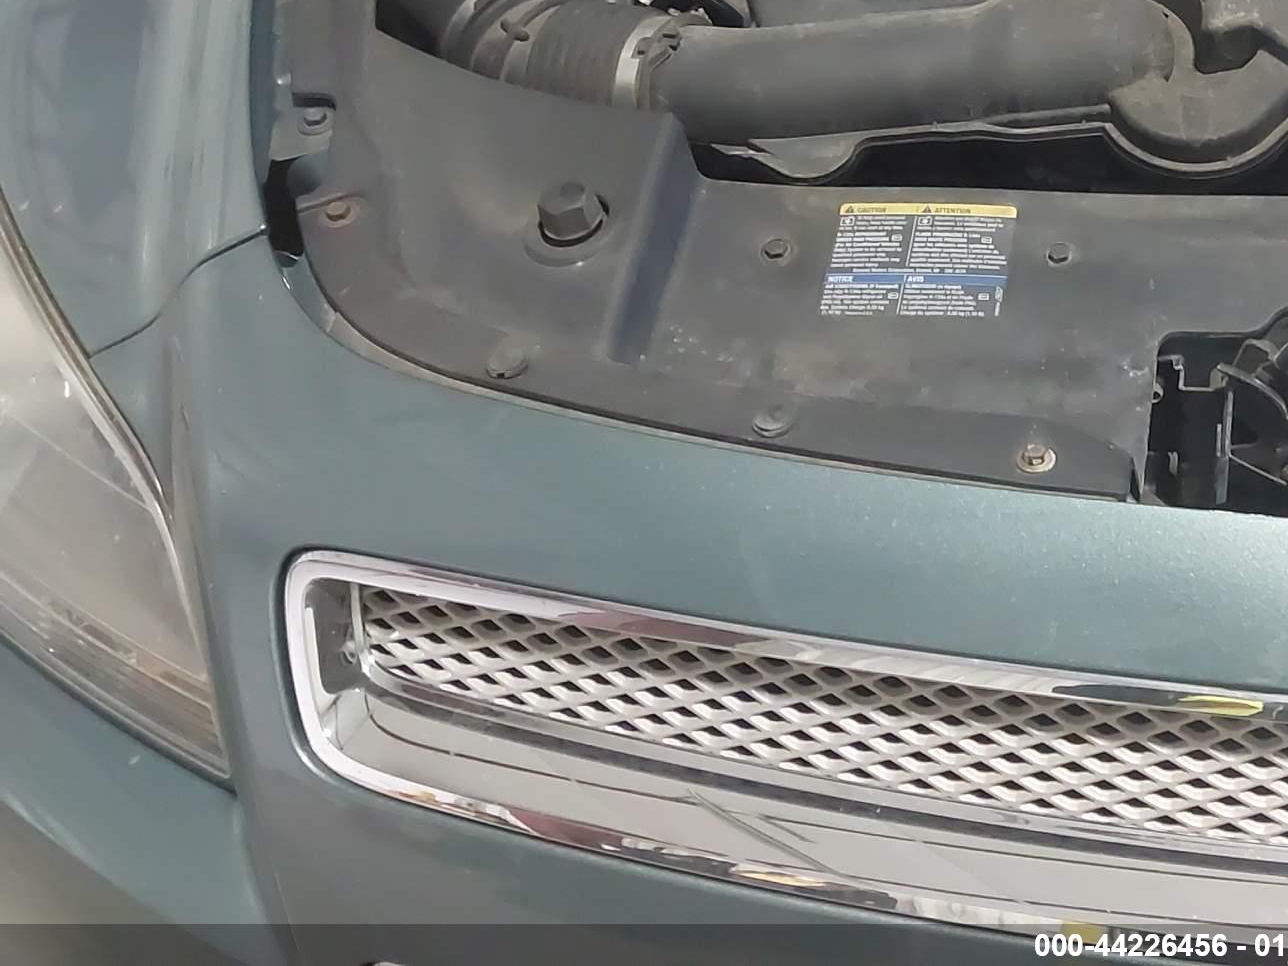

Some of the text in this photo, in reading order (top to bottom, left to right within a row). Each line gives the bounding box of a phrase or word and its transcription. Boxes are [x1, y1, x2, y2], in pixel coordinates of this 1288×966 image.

[934, 207, 972, 215] ATTENTION
[827, 275, 854, 283] NOTICE
[906, 275, 925, 283] AVIS
